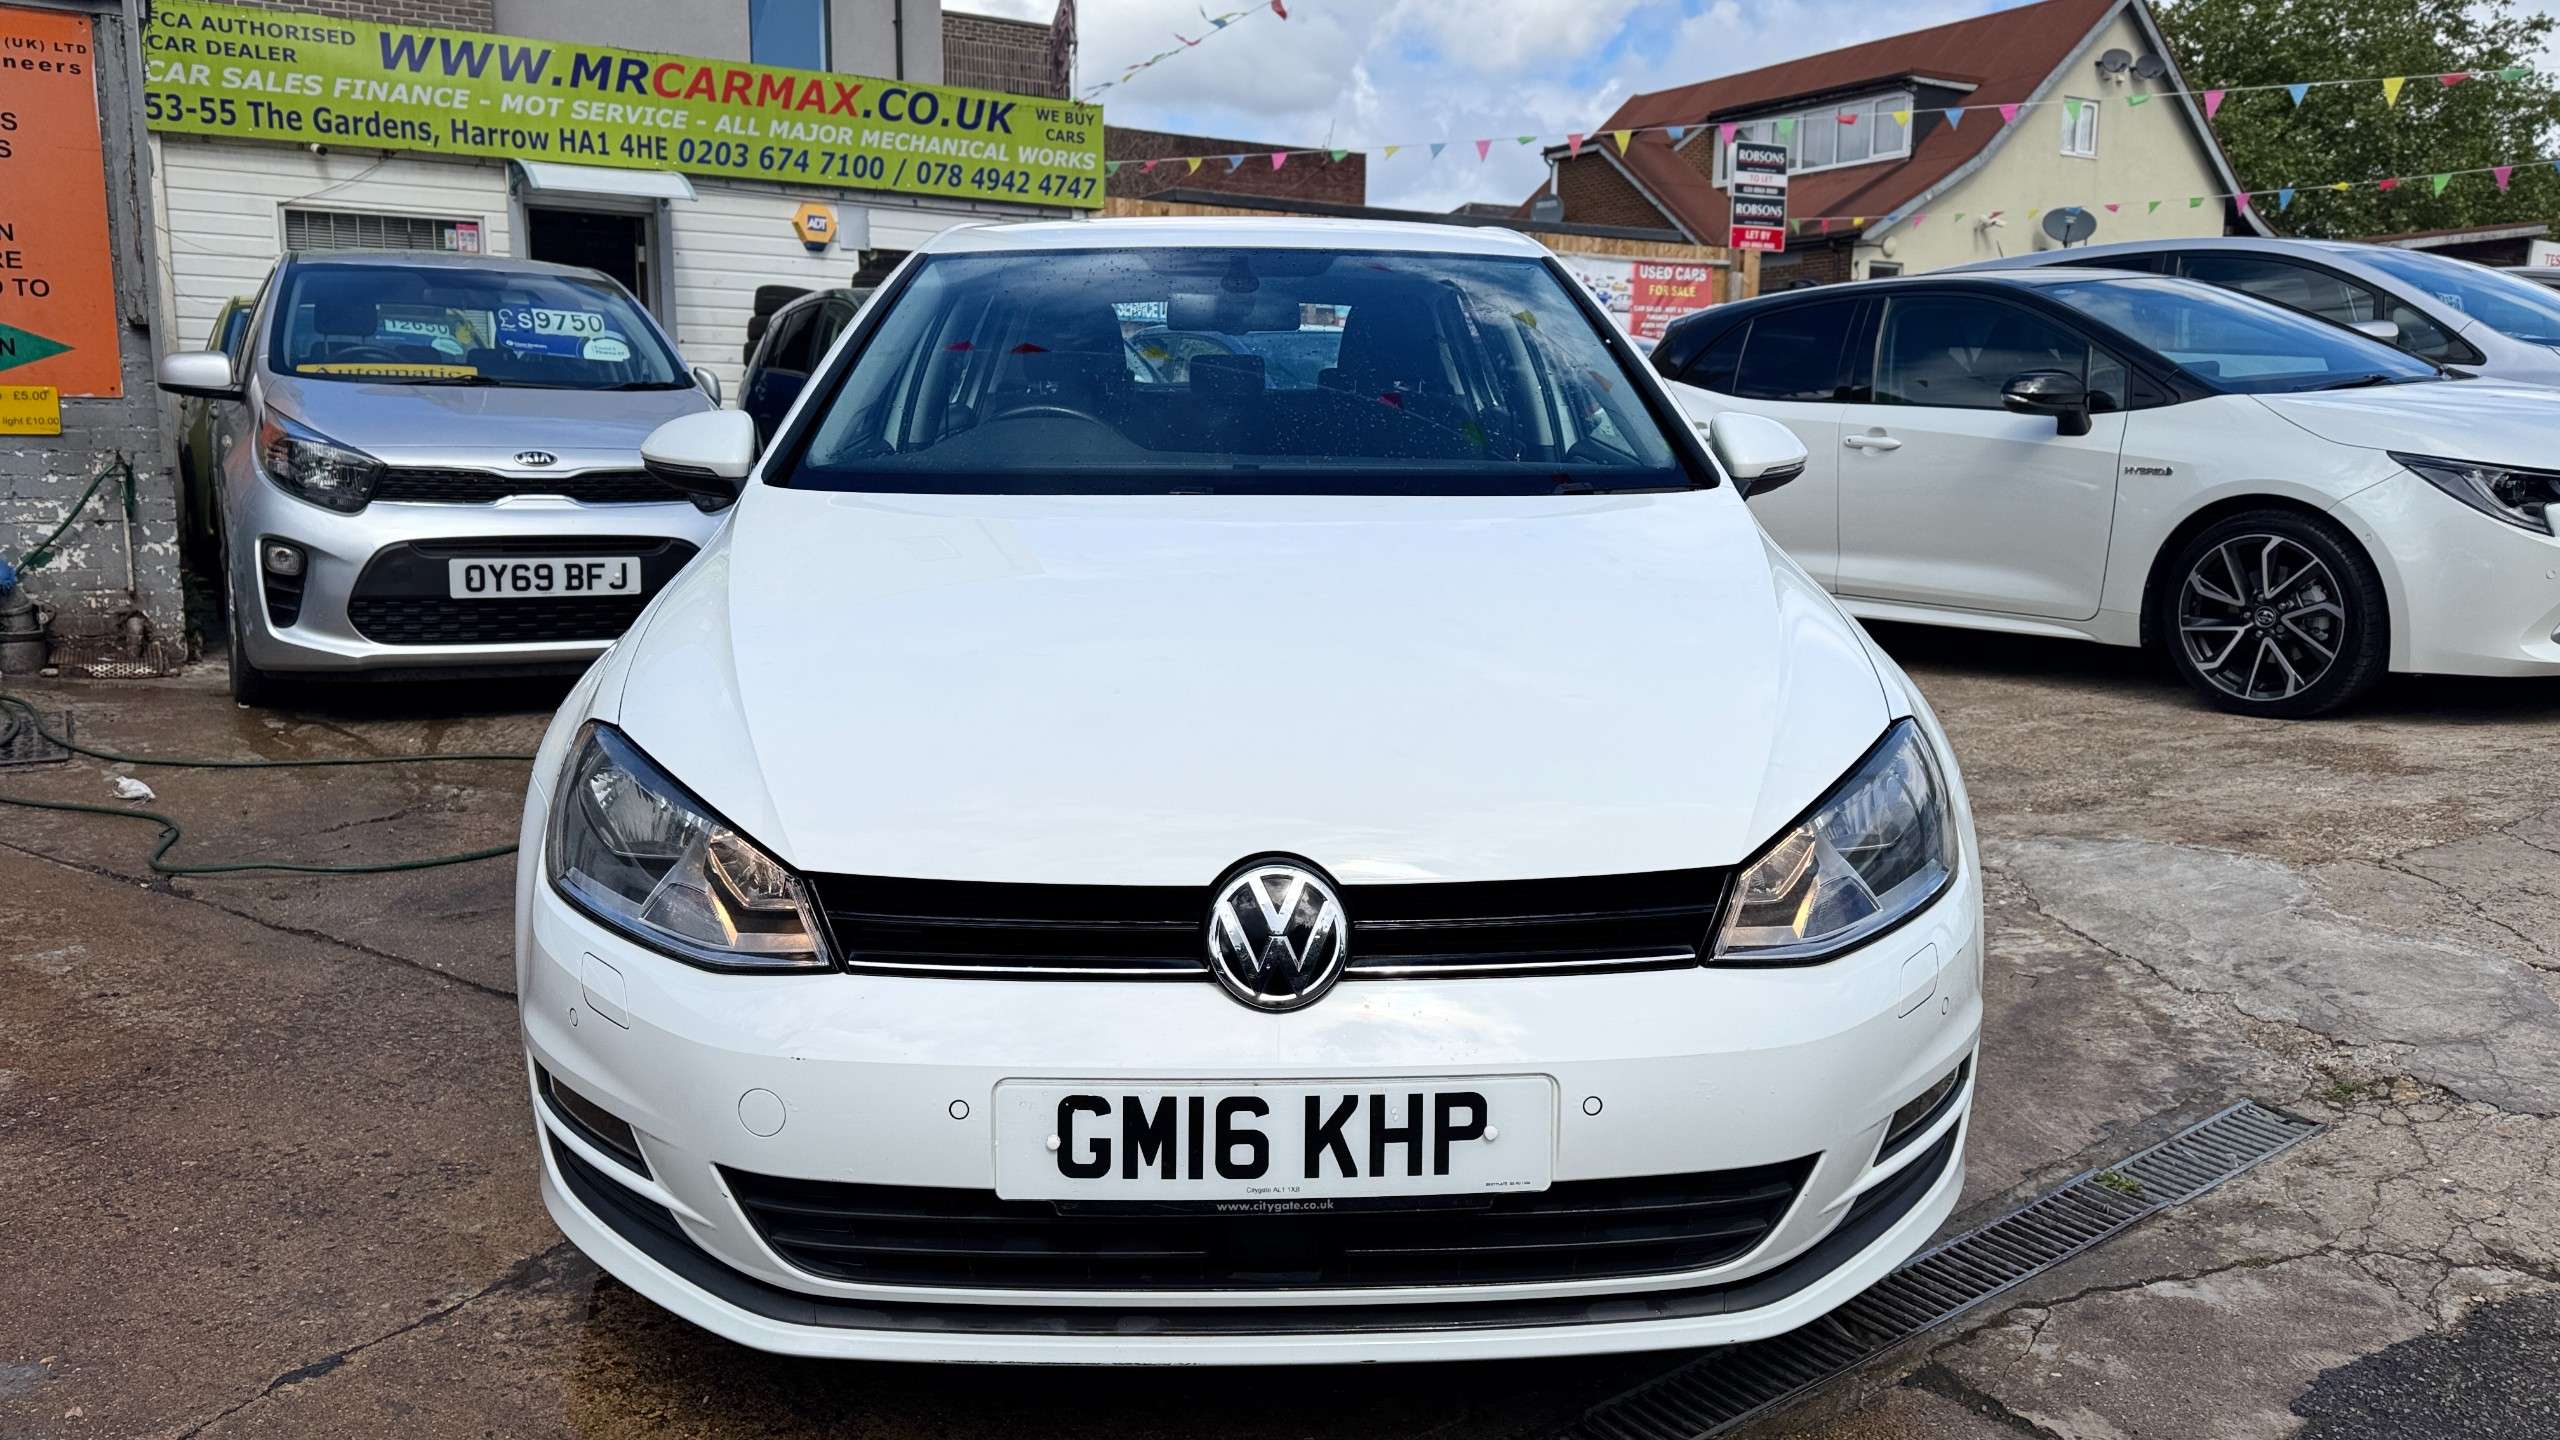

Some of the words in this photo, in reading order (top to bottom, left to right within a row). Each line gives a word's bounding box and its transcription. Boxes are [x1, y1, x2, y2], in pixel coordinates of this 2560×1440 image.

[201, 16, 356, 46] AUTHORISED
[5, 36, 45, 52] (UK)
[54, 42, 87, 54] LTD
[148, 34, 198, 54] CAR
[206, 40, 298, 63] DEALER
[379, 31, 1017, 134] WWW.MRCARMAX.CO.UK
[145, 60, 211, 87] CAR
[221, 67, 323, 97] SALES
[333, 77, 471, 110] FINANCE
[500, 93, 564, 117] MOT
[571, 99, 689, 130] SERVICE
[714, 114, 761, 137] ALL
[769, 119, 853, 145] MAJOR
[860, 128, 1010, 162] MECHANICAL
[1018, 146, 1097, 170] WORKS
[1036, 108, 1059, 123] WE
[1064, 110, 1095, 127] BUY
[144, 92, 237, 126] 53-55
[247, 100, 303, 132] The
[312, 106, 440, 148] Gardens,
[451, 118, 549, 151] Harrow
[559, 127, 610, 156] HA1
[620, 133, 668, 161] 4HE
[678, 138, 749, 168] 0203
[759, 145, 810, 173] 674
[820, 150, 885, 181] 7100
[892, 158, 907, 187] /
[916, 161, 963, 188] 078
[971, 167, 1030, 194] 4942
[1038, 173, 1097, 199] 4747
[1045, 128, 1086, 144] CARS
[1738, 149, 1785, 165] ROBSONS
[1735, 203, 1783, 217] ROBSONS
[1745, 230, 1760, 240] LET
[1640, 264, 1673, 281] USED
[1675, 267, 1708, 282] CARS
[12, 278, 50, 298] TO
[1648, 284, 1670, 297] FOR
[1670, 286, 1697, 297] SALE
[465, 563, 554, 593] OY69
[564, 562, 628, 591] BFJ
[1057, 1094, 1270, 1180] GM16
[1304, 1091, 1488, 1179] KHP
[1216, 1199, 1335, 1213] www.citygate.co.uk
